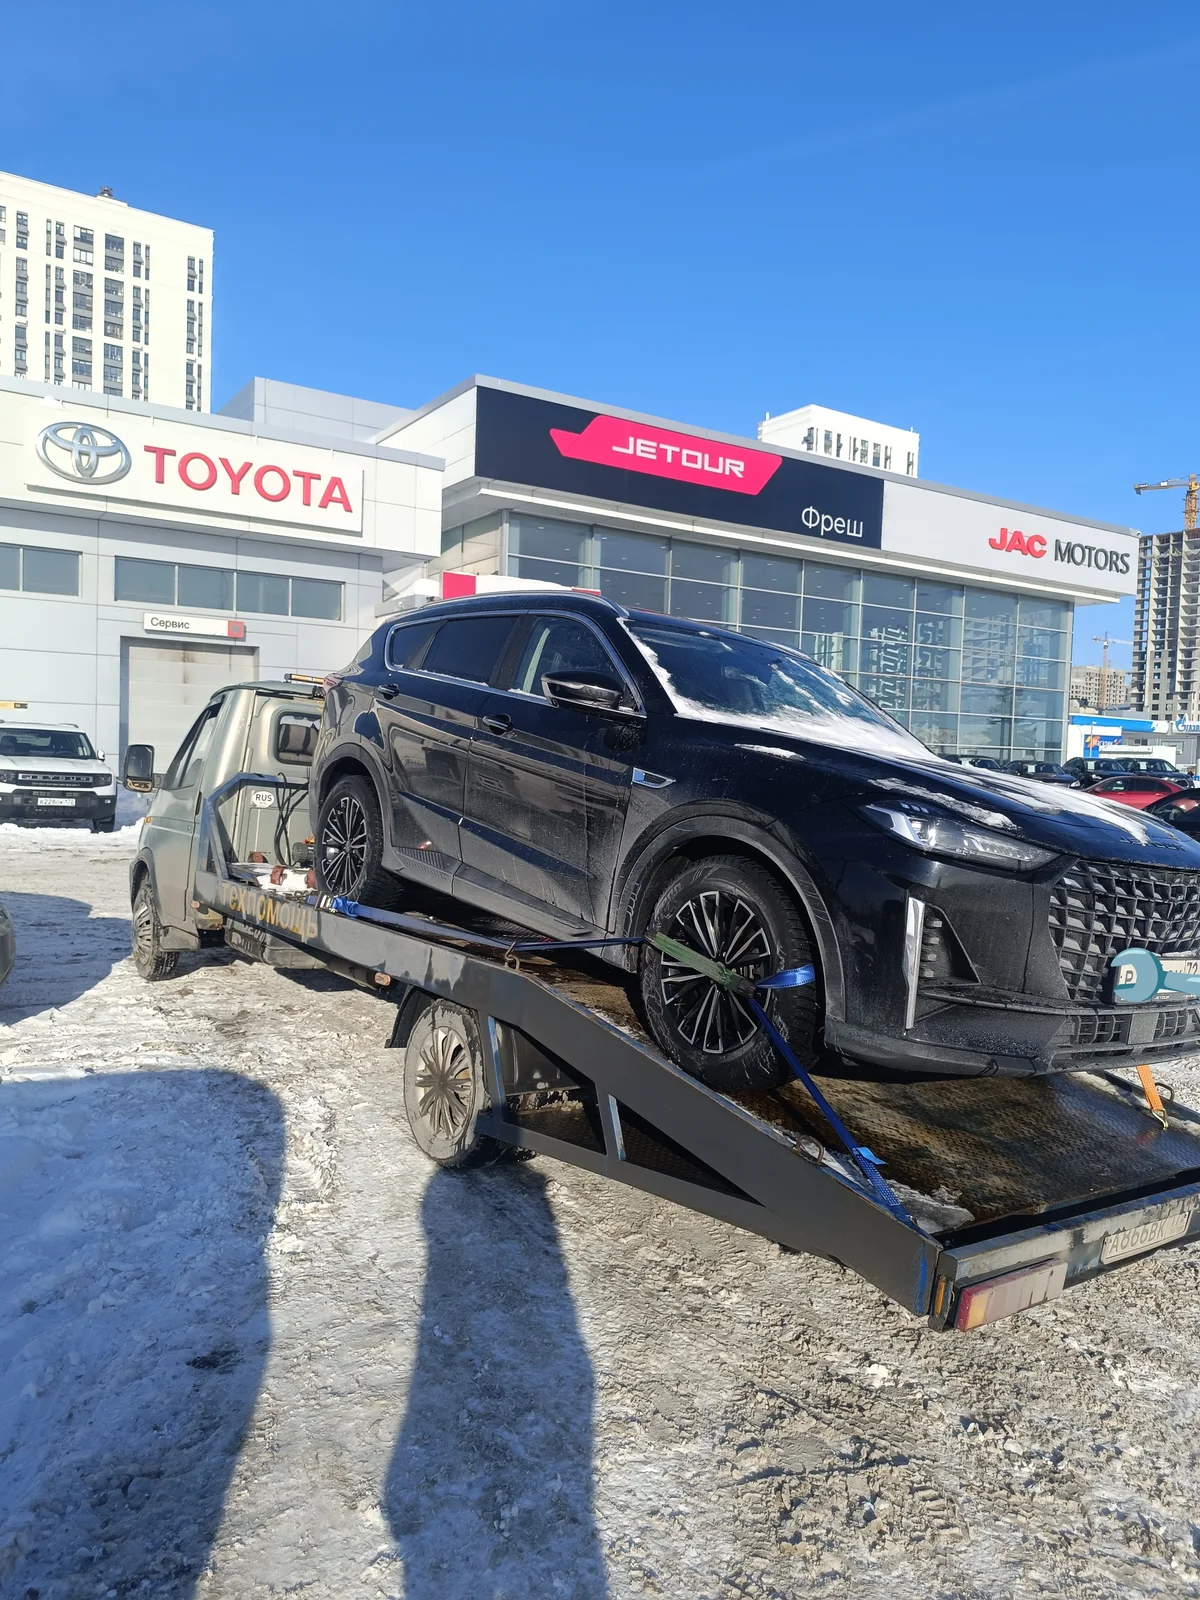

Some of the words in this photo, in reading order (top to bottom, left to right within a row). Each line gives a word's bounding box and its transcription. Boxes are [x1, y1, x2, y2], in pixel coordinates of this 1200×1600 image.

[612, 436, 744, 478] JETOUR
[144, 445, 353, 513] TOYOTA
[801, 506, 863, 538] Фреш
[988, 527, 1047, 559] JAC
[1054, 539, 1130, 574] MOTORS
[150, 617, 190, 629] Сервис
[255, 793, 273, 802] RUS
